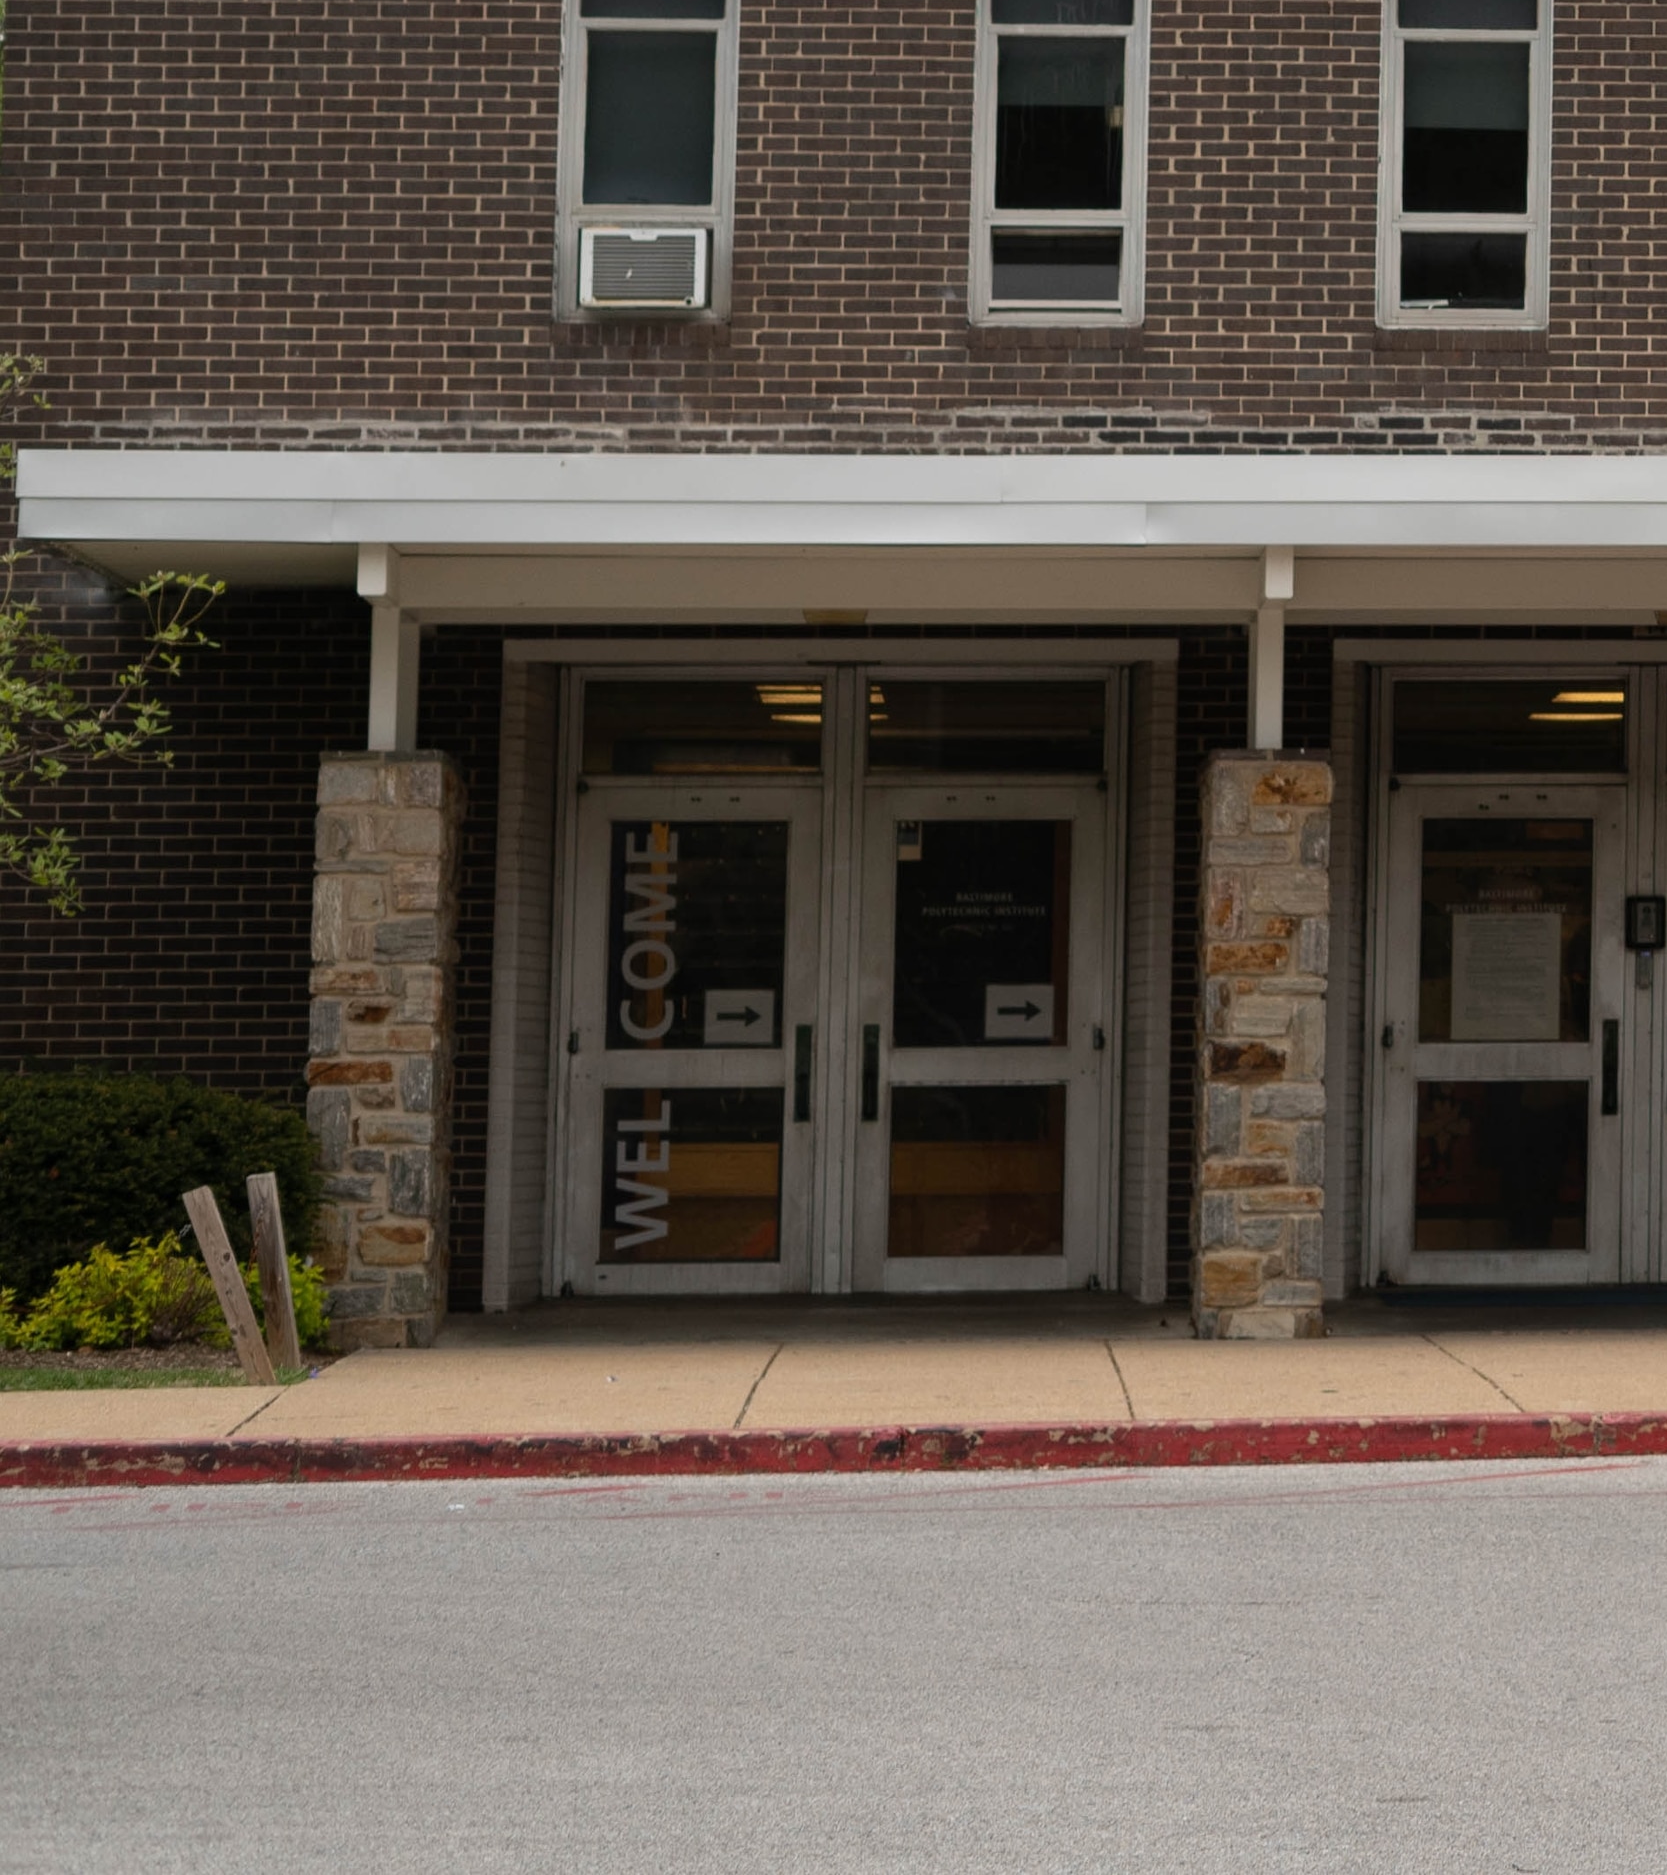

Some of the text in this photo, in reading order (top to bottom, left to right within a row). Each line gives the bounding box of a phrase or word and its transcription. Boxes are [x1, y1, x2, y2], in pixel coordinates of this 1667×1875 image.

[955, 891, 1014, 902] BALTIMORE
[614, 831, 679, 1251] WEL COME
